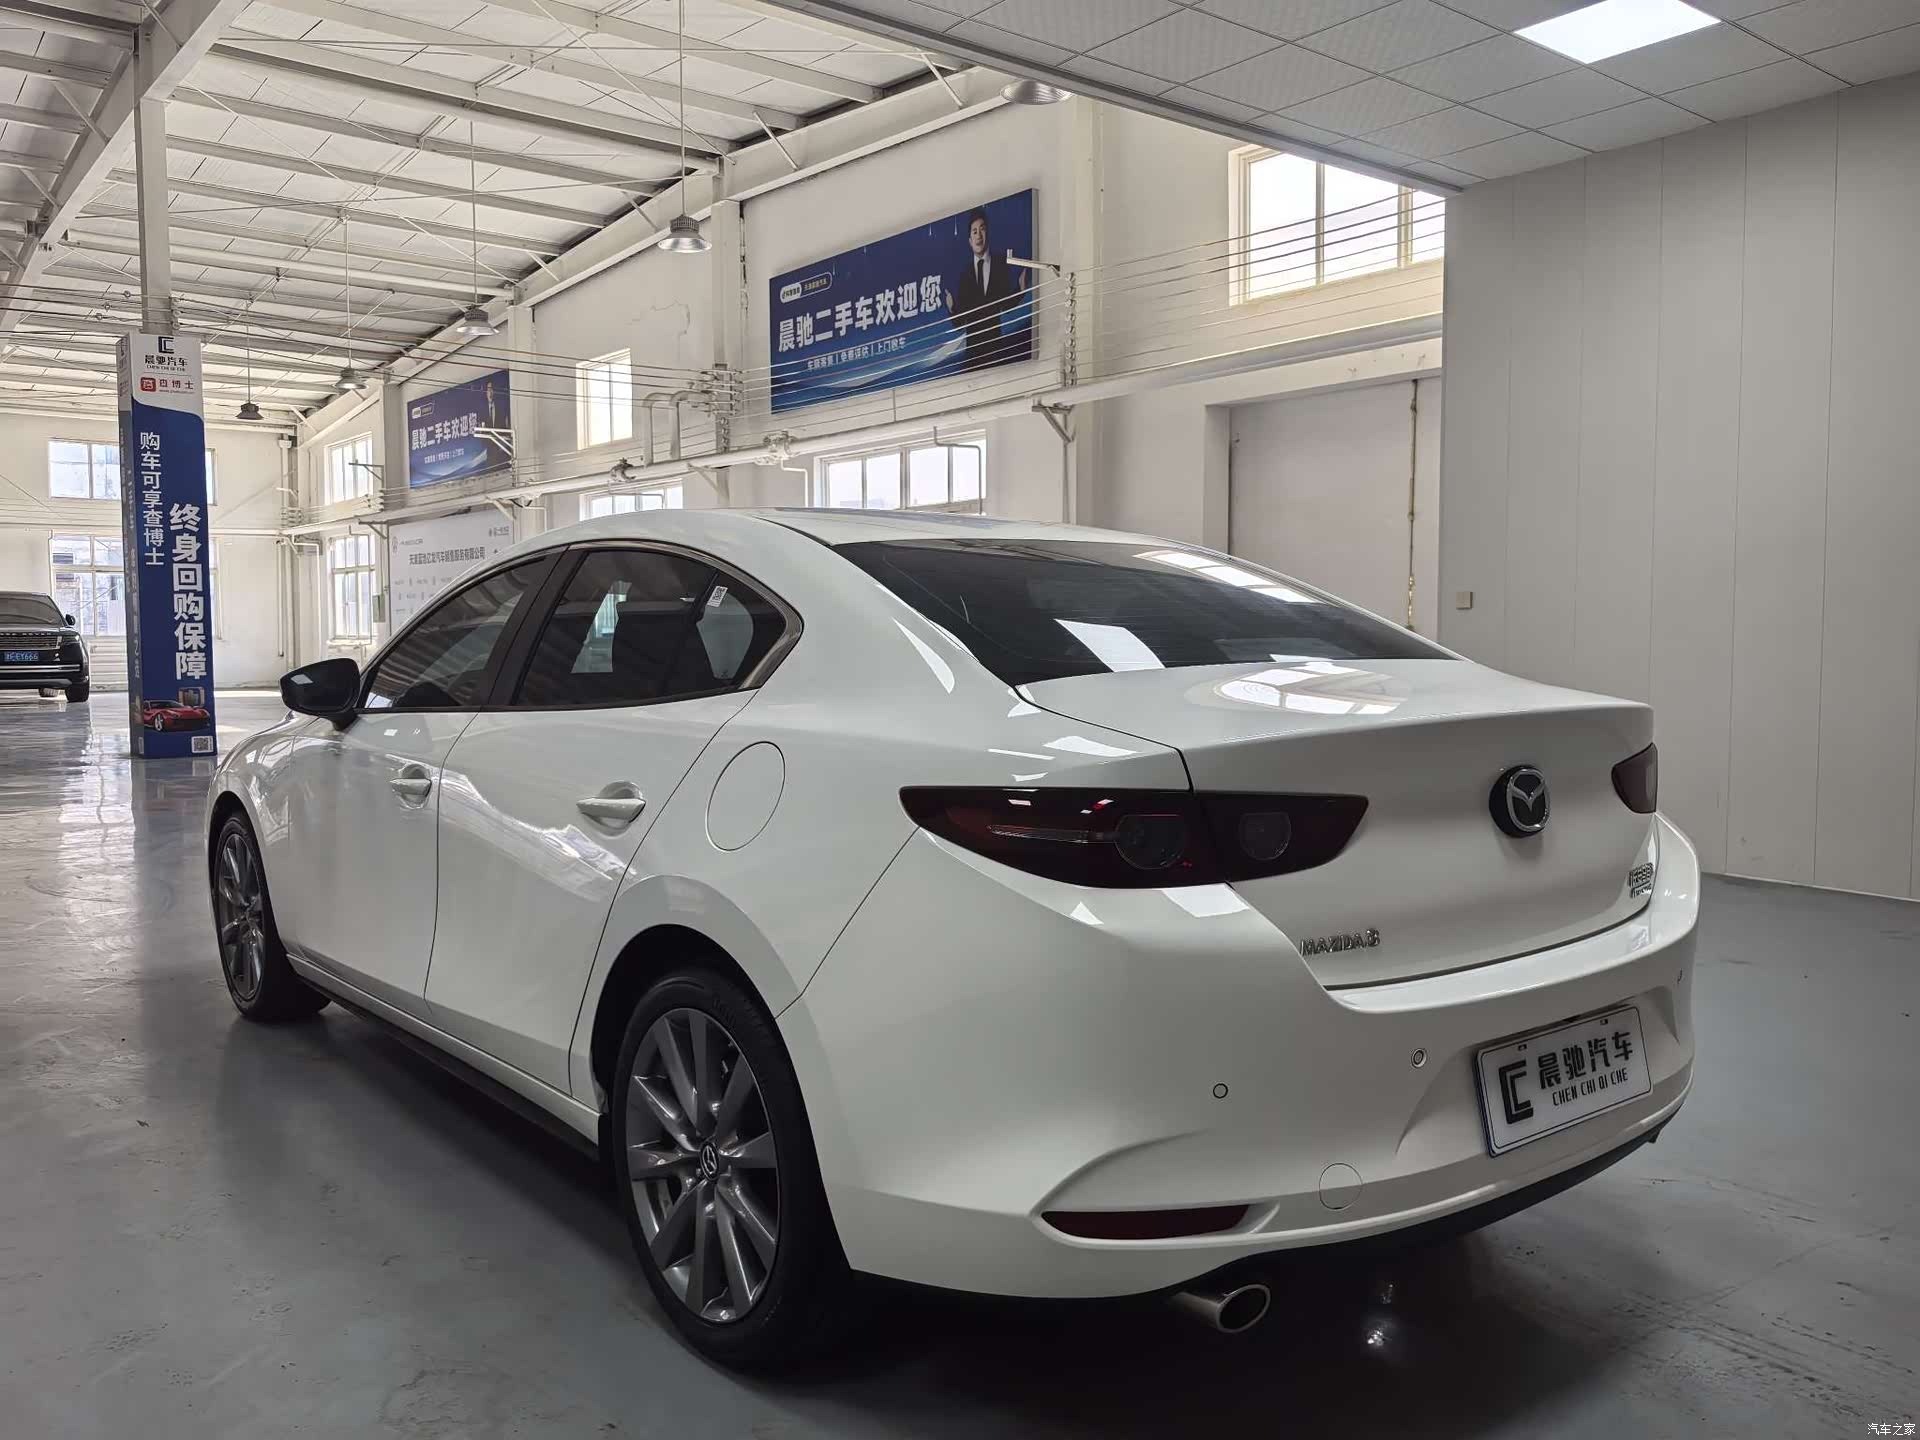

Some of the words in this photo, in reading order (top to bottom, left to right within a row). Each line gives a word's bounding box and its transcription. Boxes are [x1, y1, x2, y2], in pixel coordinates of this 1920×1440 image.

[778, 275, 942, 352] 晨驰二手车欢迎您
[412, 412, 478, 450] 晨驰二手车欢迎您
[140, 431, 165, 566] 购车可享查博士
[169, 502, 207, 680] 终身回购保障
[1538, 1032, 1633, 1090] 晨驰汽车
[1552, 1085, 1578, 1107] CHEN
[1581, 1080, 1597, 1096] CHI
[1599, 1076, 1609, 1091] QI
[1611, 1067, 1629, 1086] CHE
